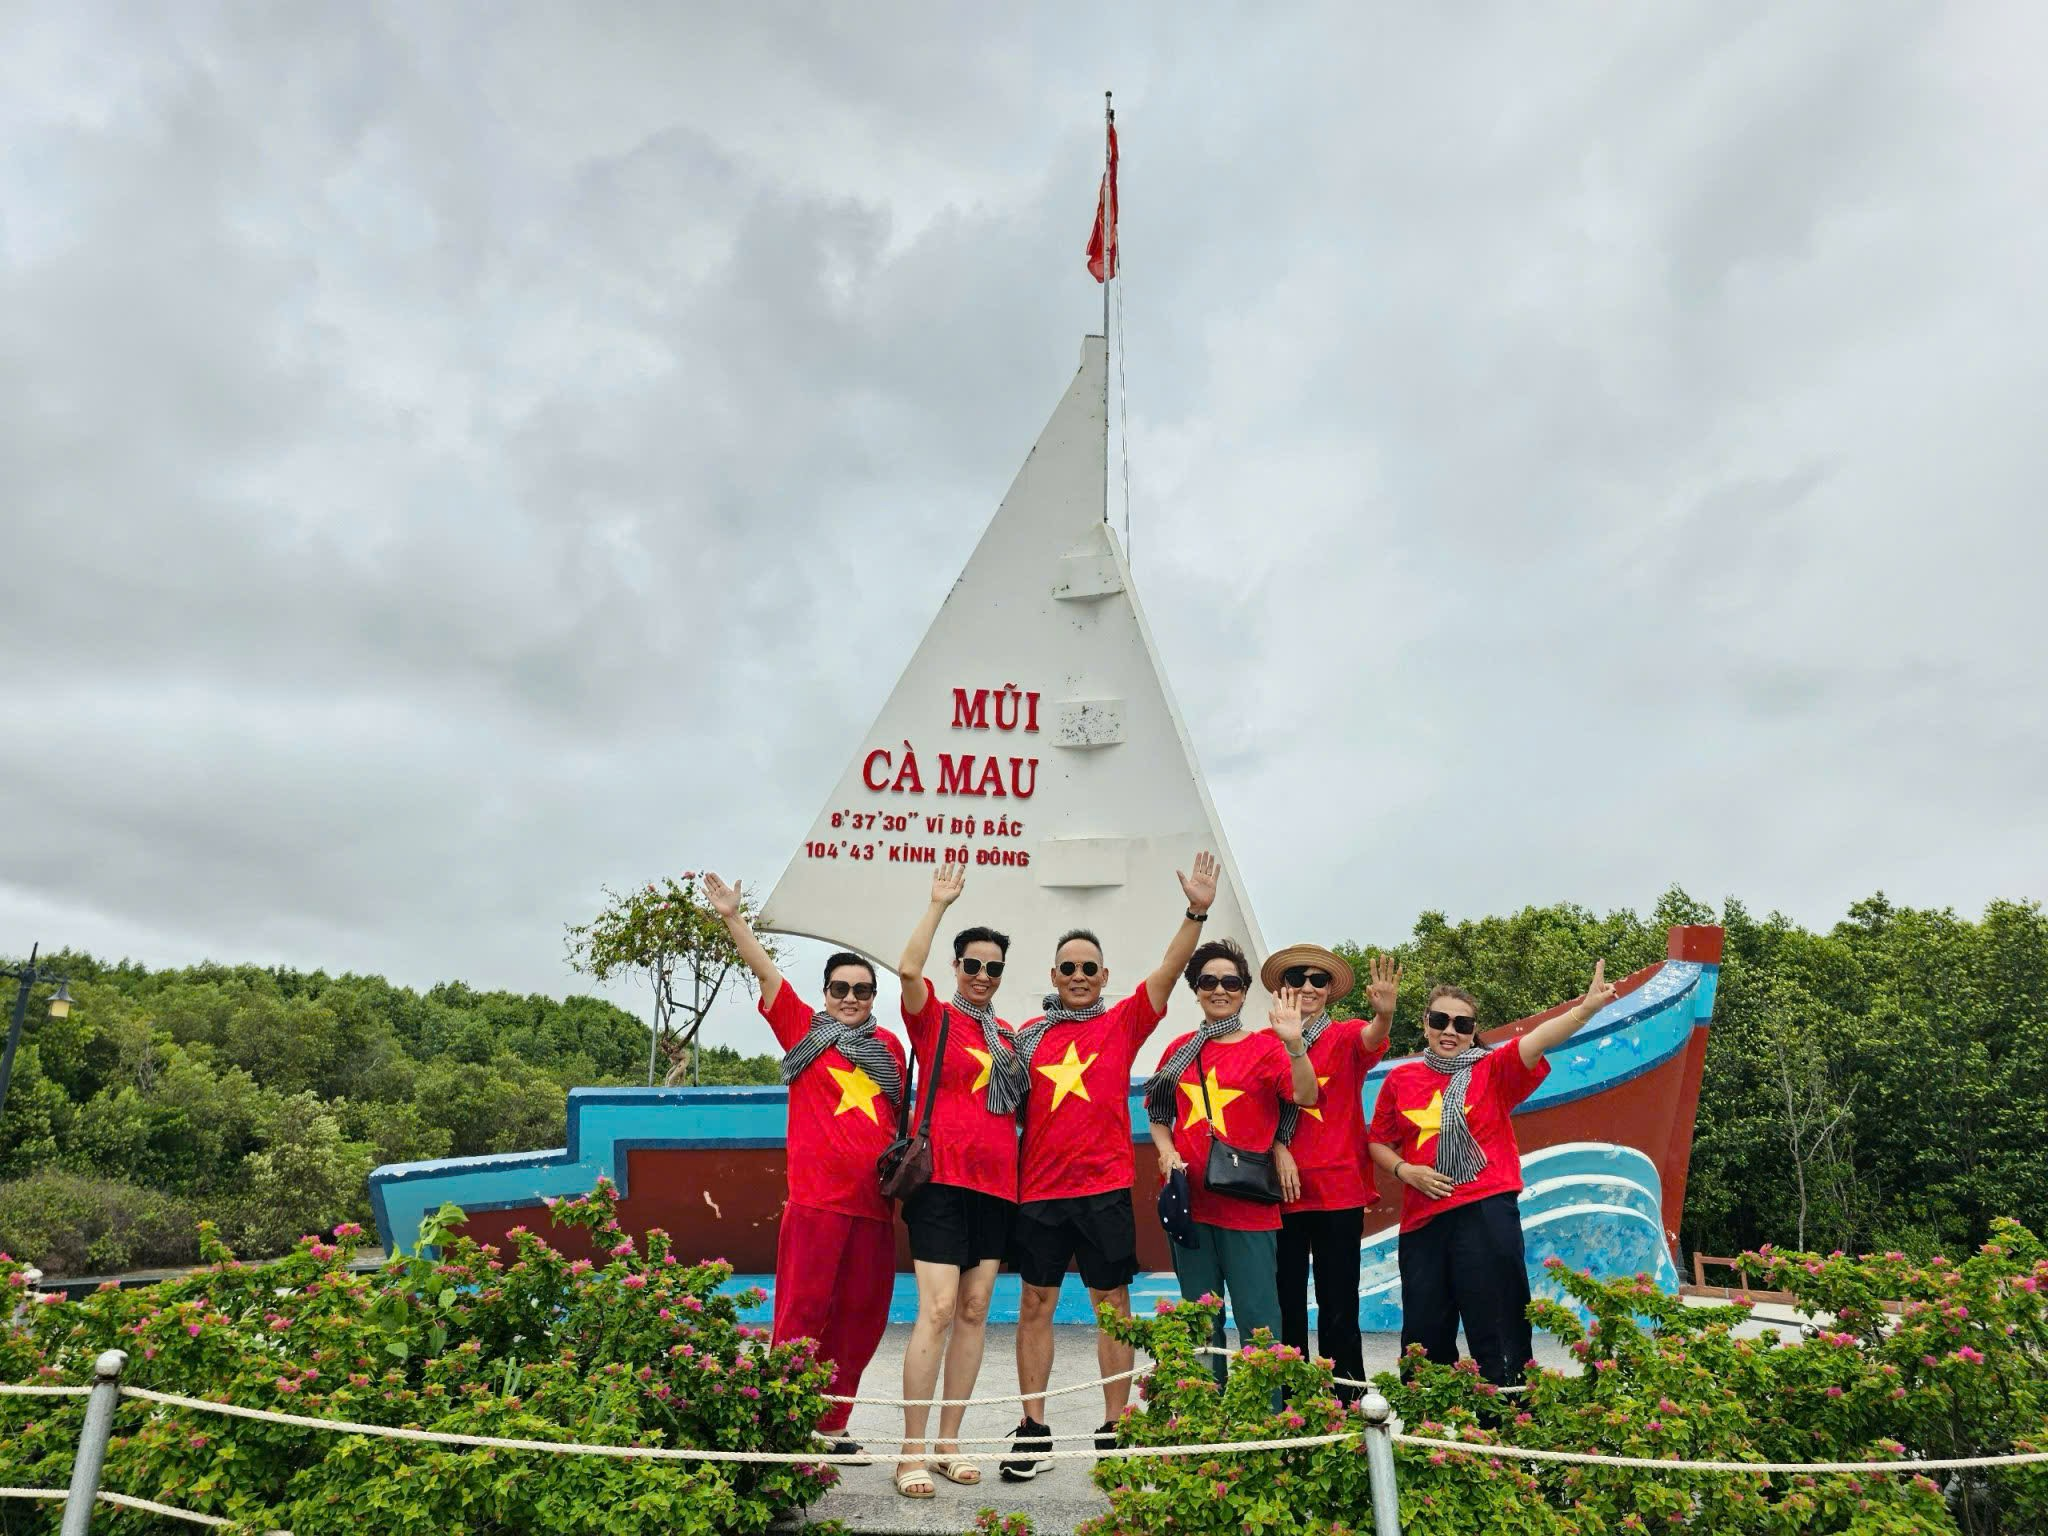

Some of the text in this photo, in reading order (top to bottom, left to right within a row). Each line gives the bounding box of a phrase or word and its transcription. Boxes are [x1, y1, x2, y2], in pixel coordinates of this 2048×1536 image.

[952, 683, 1041, 733] MŨI
[862, 739, 1039, 799] CÀ MAU
[926, 813, 945, 834] VĨ
[950, 814, 975, 838] ĐỘ
[983, 813, 1024, 837] BẮC
[975, 845, 1030, 867] ĐÔNG
